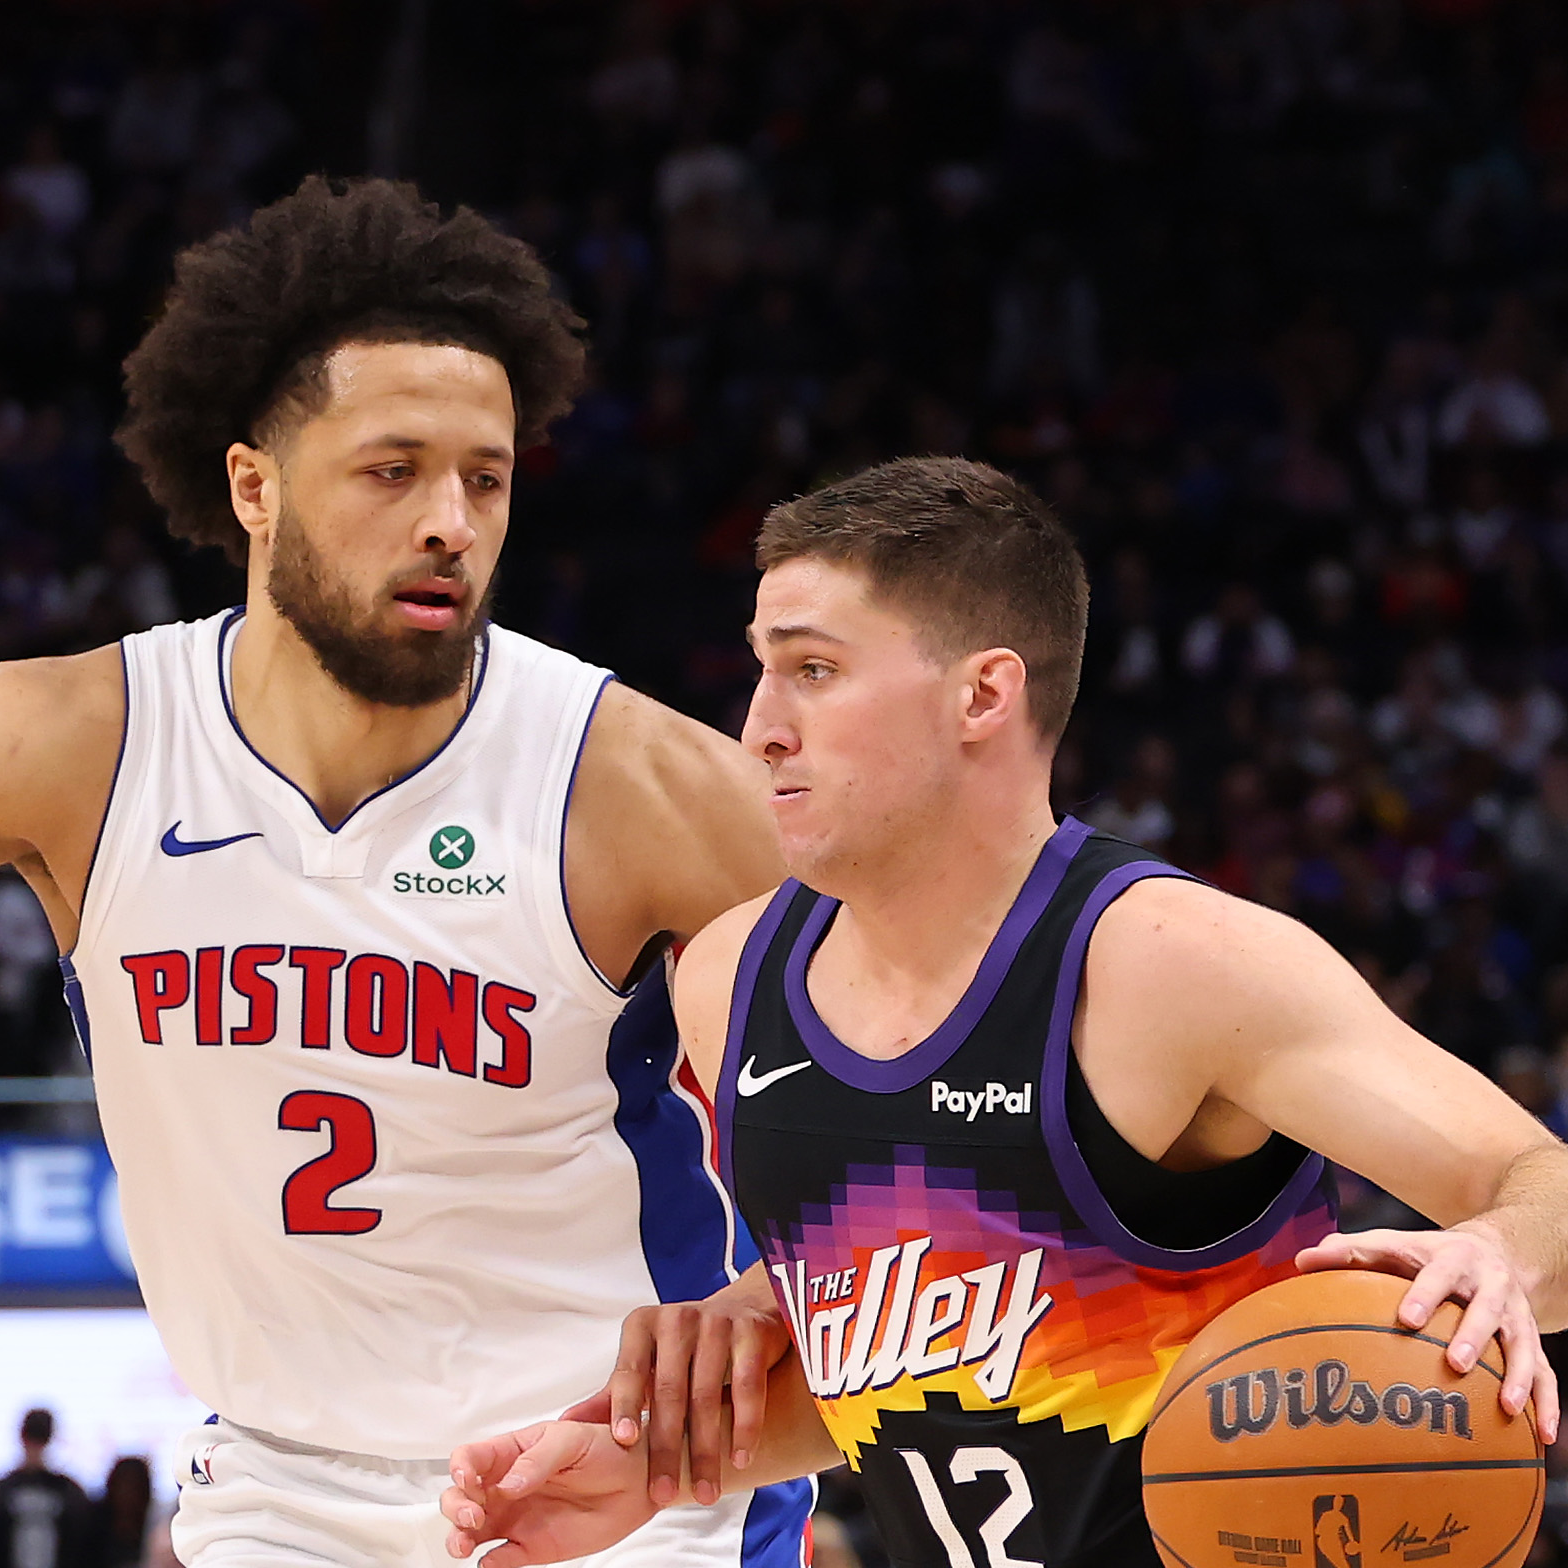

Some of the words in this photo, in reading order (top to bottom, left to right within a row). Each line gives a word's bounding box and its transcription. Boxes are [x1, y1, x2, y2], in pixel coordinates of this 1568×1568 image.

[393, 872, 506, 896] StockX
[120, 943, 537, 1089] PISTONS
[930, 1080, 1032, 1122] PayPal
[277, 1090, 382, 1236] 2
[770, 1235, 1056, 1403] Valley
[809, 1266, 858, 1303] THE
[1205, 1358, 1473, 1443] Wilson
